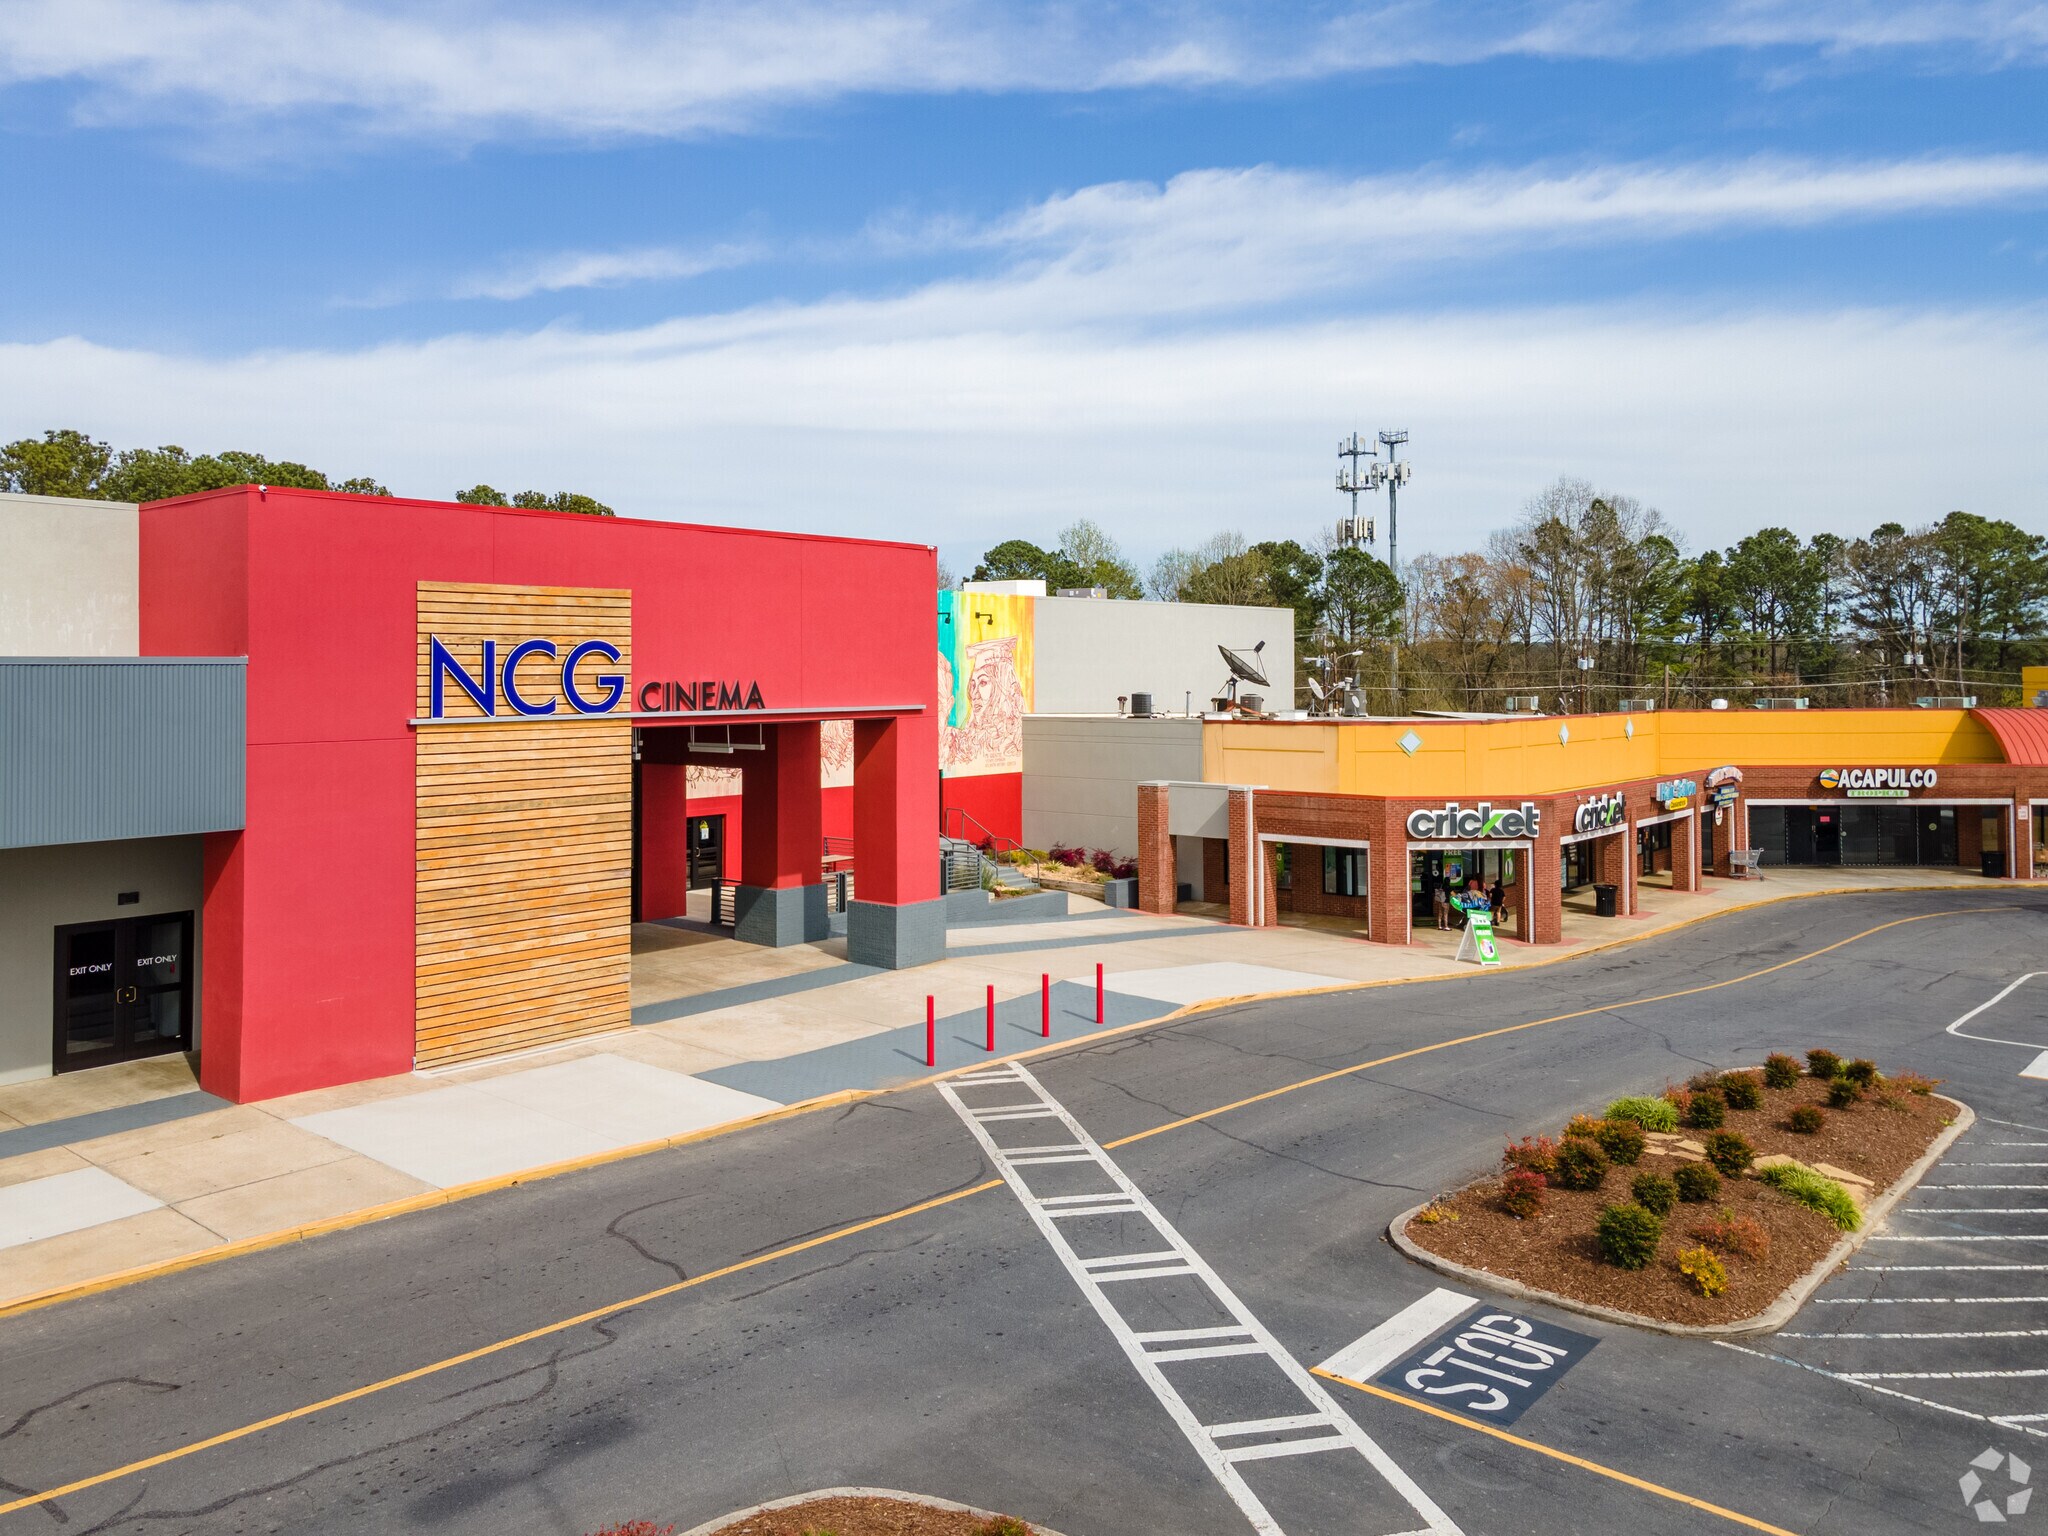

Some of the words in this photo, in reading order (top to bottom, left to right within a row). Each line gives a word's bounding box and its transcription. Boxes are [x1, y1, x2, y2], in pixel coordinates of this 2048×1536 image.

[429, 632, 626, 719] NCG
[639, 680, 766, 713] CINEMA
[1837, 768, 1937, 788] ACAPULCO
[1849, 789, 1906, 797] TROPICAL
[1406, 802, 1540, 839] cricket
[1576, 791, 1627, 833] cricket
[70, 966, 88, 976] EXIT
[88, 963, 112, 973] ONLY
[138, 957, 154, 967] EXIT
[154, 954, 178, 964] ONLY
[1404, 1313, 1568, 1411] STOP
